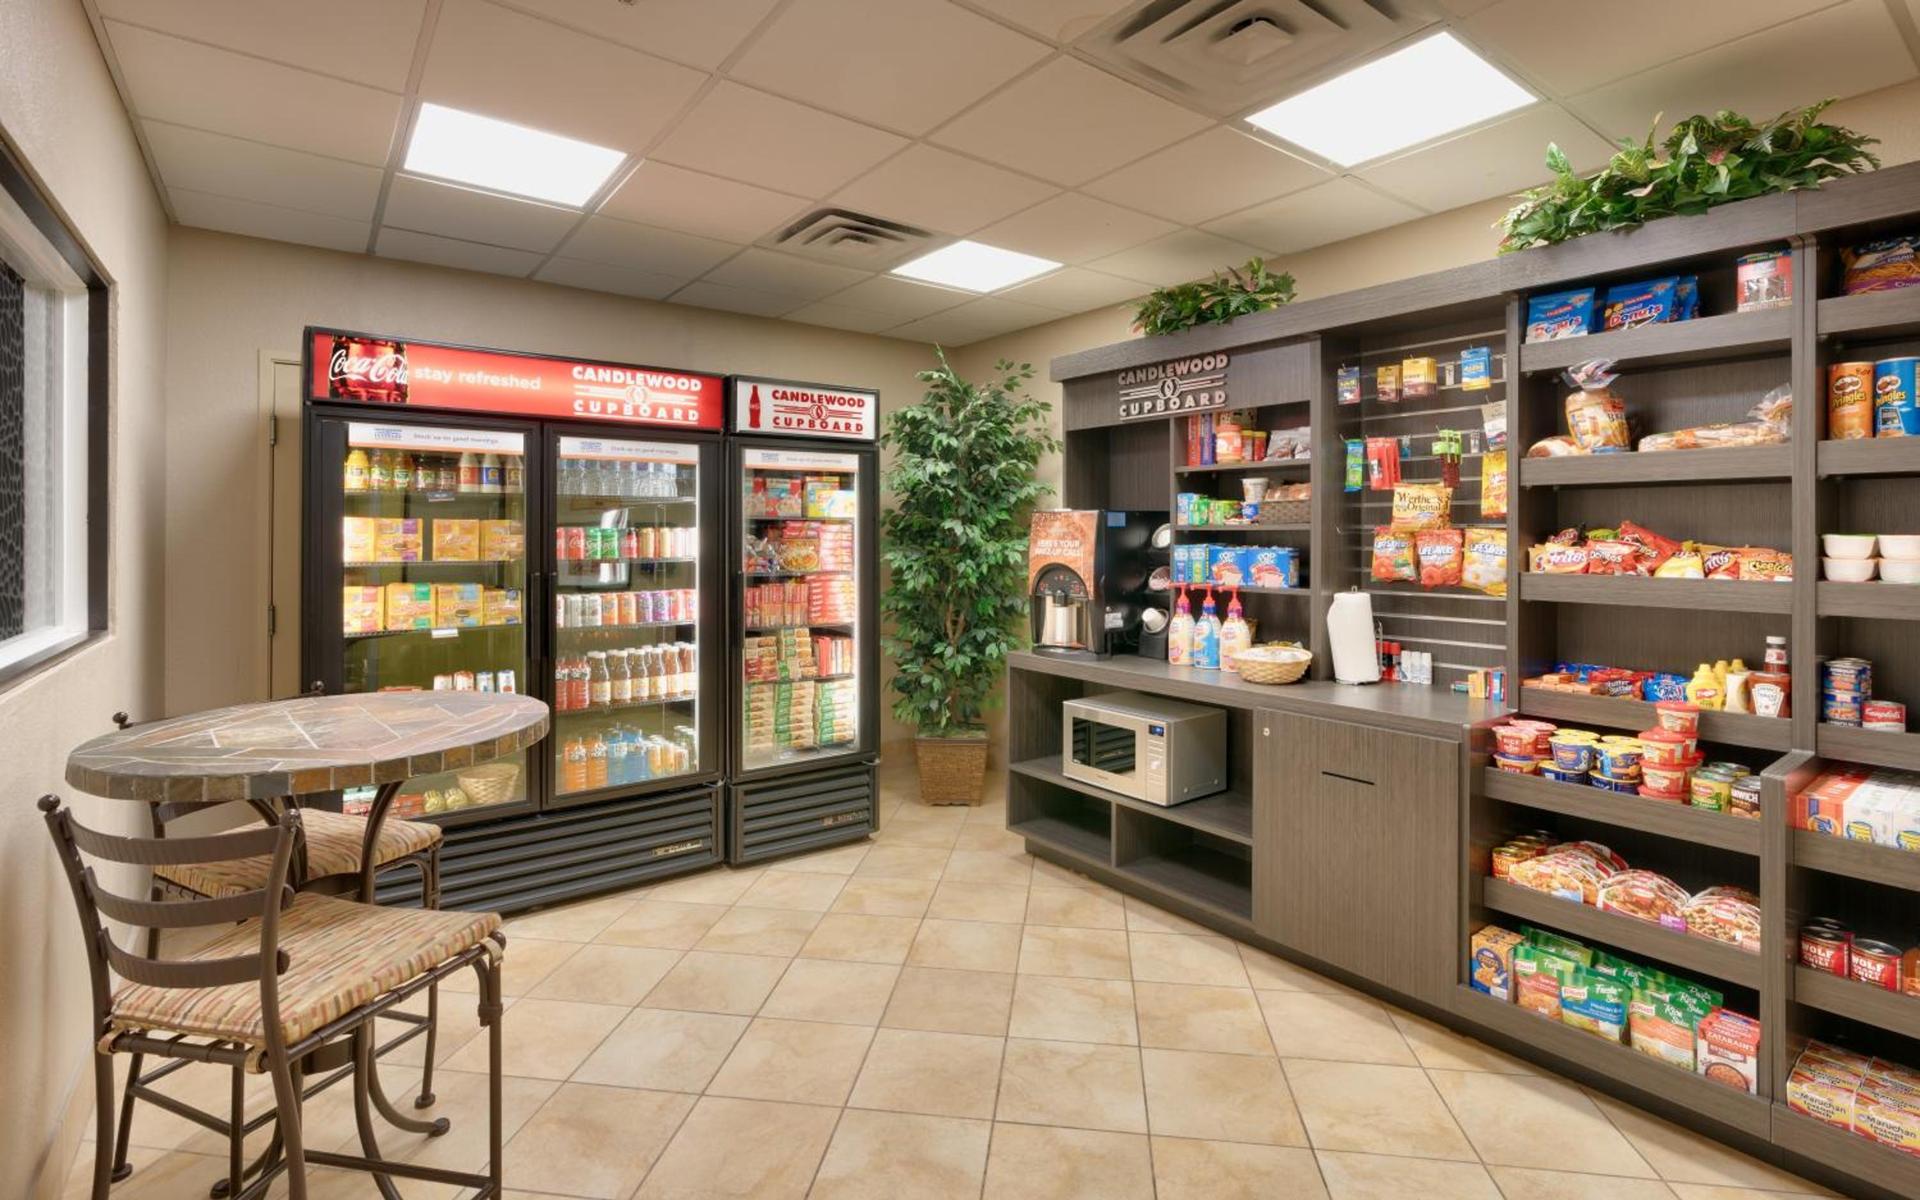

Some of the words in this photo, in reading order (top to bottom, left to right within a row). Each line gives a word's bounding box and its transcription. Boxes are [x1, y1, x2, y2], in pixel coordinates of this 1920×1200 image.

[1610, 304, 1663, 327] Donuts
[414, 366, 451, 384] stay
[458, 370, 542, 390] refreshed
[572, 366, 703, 391] CANDLEWOOD
[1118, 354, 1228, 384] CANDLEWOOD
[771, 389, 866, 408] CANDLEWOOD
[1119, 390, 1227, 417] CUPBOARD
[1833, 389, 1867, 409] Pringles
[573, 400, 699, 422] CUPBOARD
[772, 416, 864, 432] CUPBOARD
[1802, 941, 1833, 959] WOLF
[1852, 953, 1885, 972] WOLF
[1800, 1092, 1847, 1115] Maruchan
[1866, 1115, 1917, 1139] Maruchan
